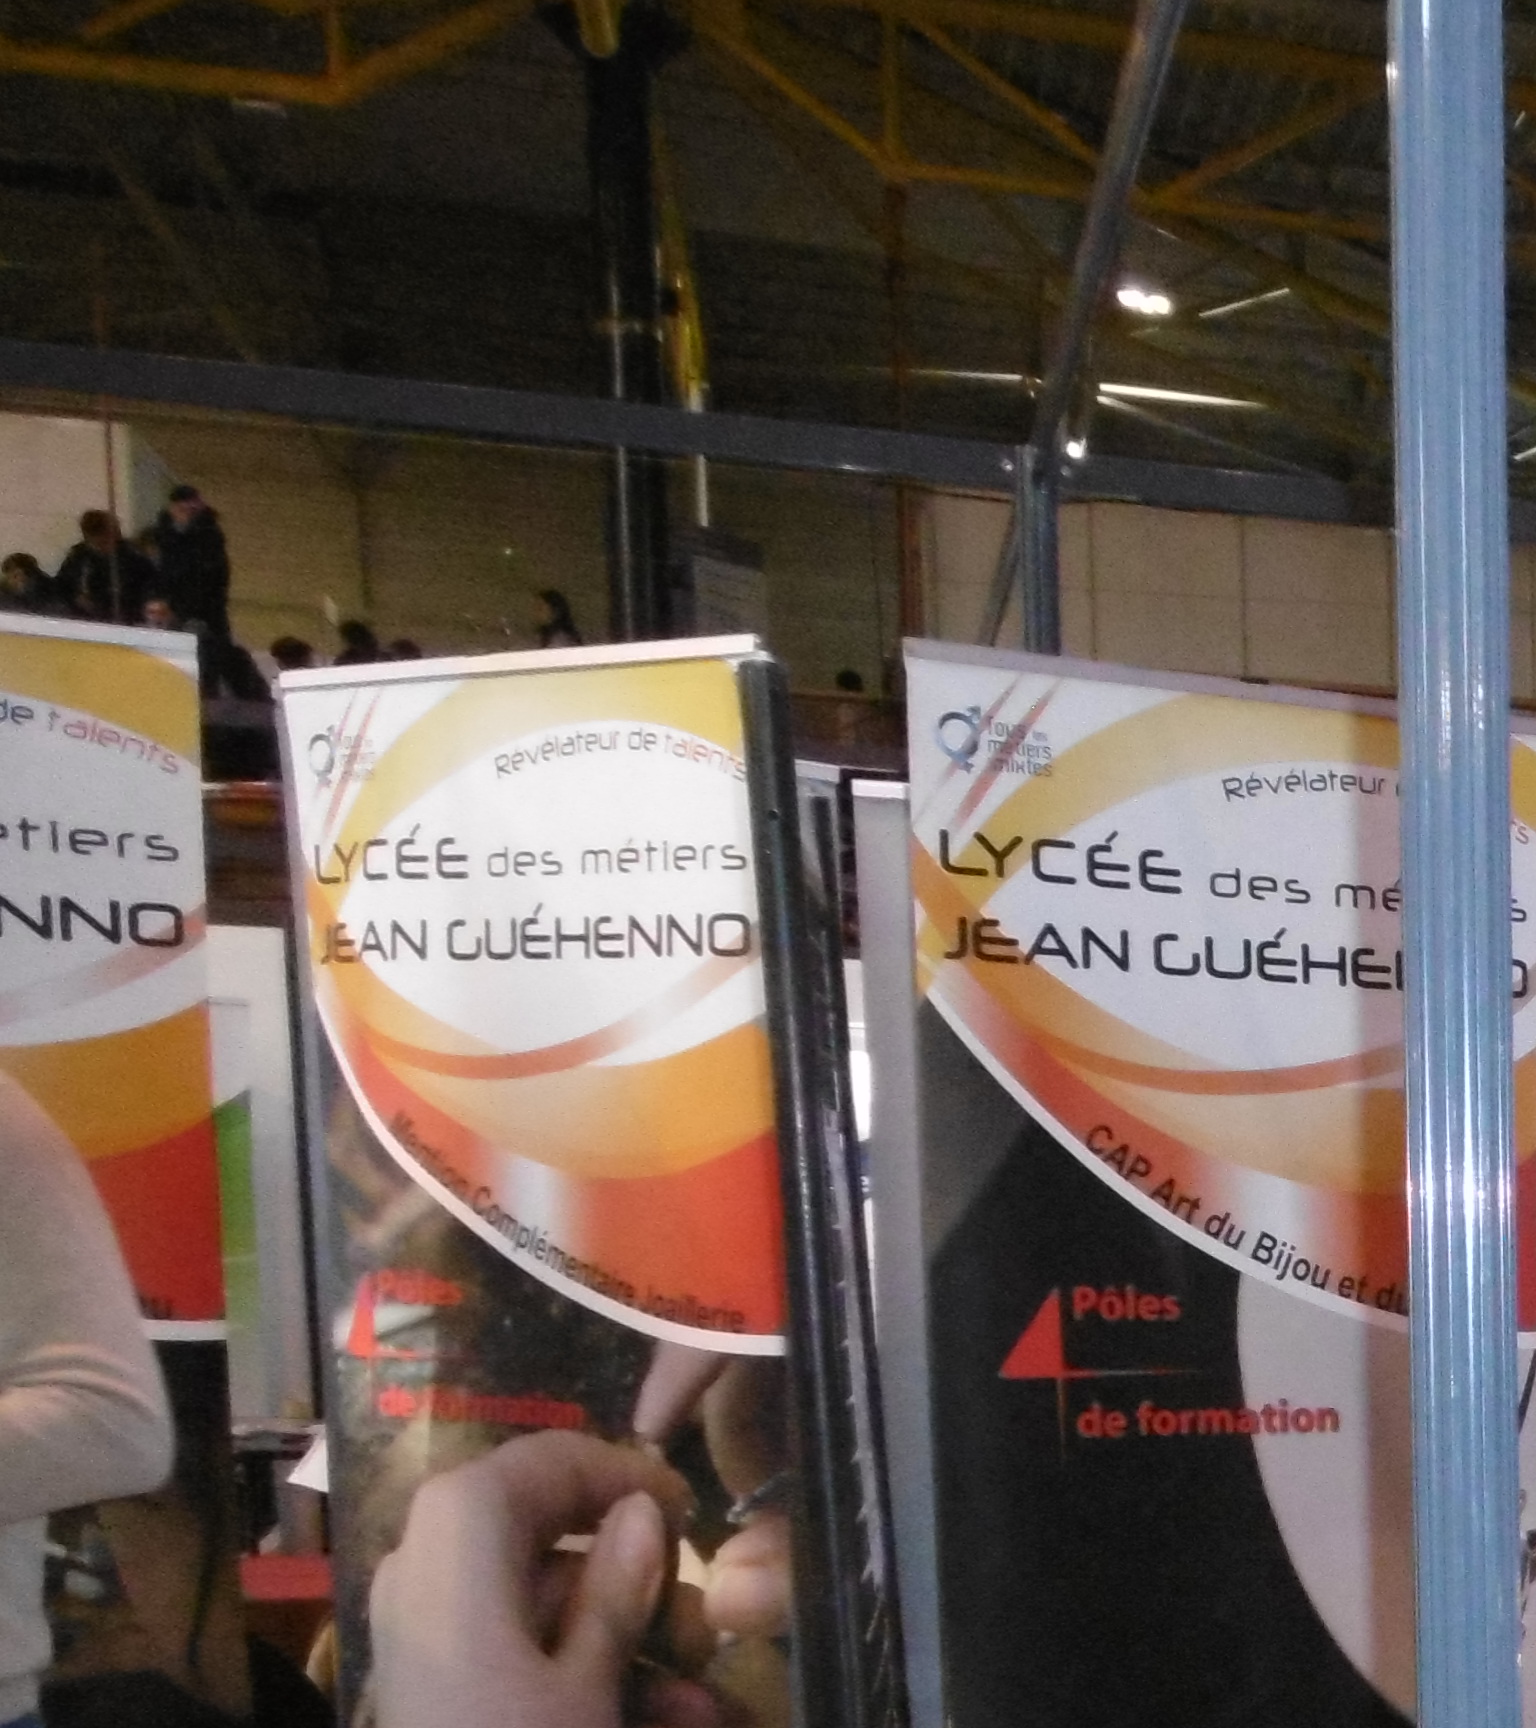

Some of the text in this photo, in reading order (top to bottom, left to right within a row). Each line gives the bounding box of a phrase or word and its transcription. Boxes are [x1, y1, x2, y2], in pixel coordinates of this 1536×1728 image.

[49, 710, 180, 774] talents
[494, 727, 748, 783] Révélateur de talents
[1222, 768, 1385, 802] Révélateur
[0, 817, 180, 862] tiers
[313, 822, 748, 885] LYCÉE des métiers
[939, 830, 1183, 895] LYCÉE
[1209, 867, 1311, 905] des
[320, 902, 752, 965] JEAN GUÉHENNO
[943, 916, 1529, 999] JEAN GUÉHE
[1085, 1124, 1153, 1180] CAP
[1150, 1177, 1202, 1225] Art
[1203, 1212, 1247, 1251] du
[1251, 1230, 1332, 1291] Bijou
[1338, 1275, 1368, 1305] et
[472, 1186, 636, 1307] Complémentaire
[1072, 1284, 1182, 1321] Pôles
[1077, 1398, 1341, 1438] de formation
